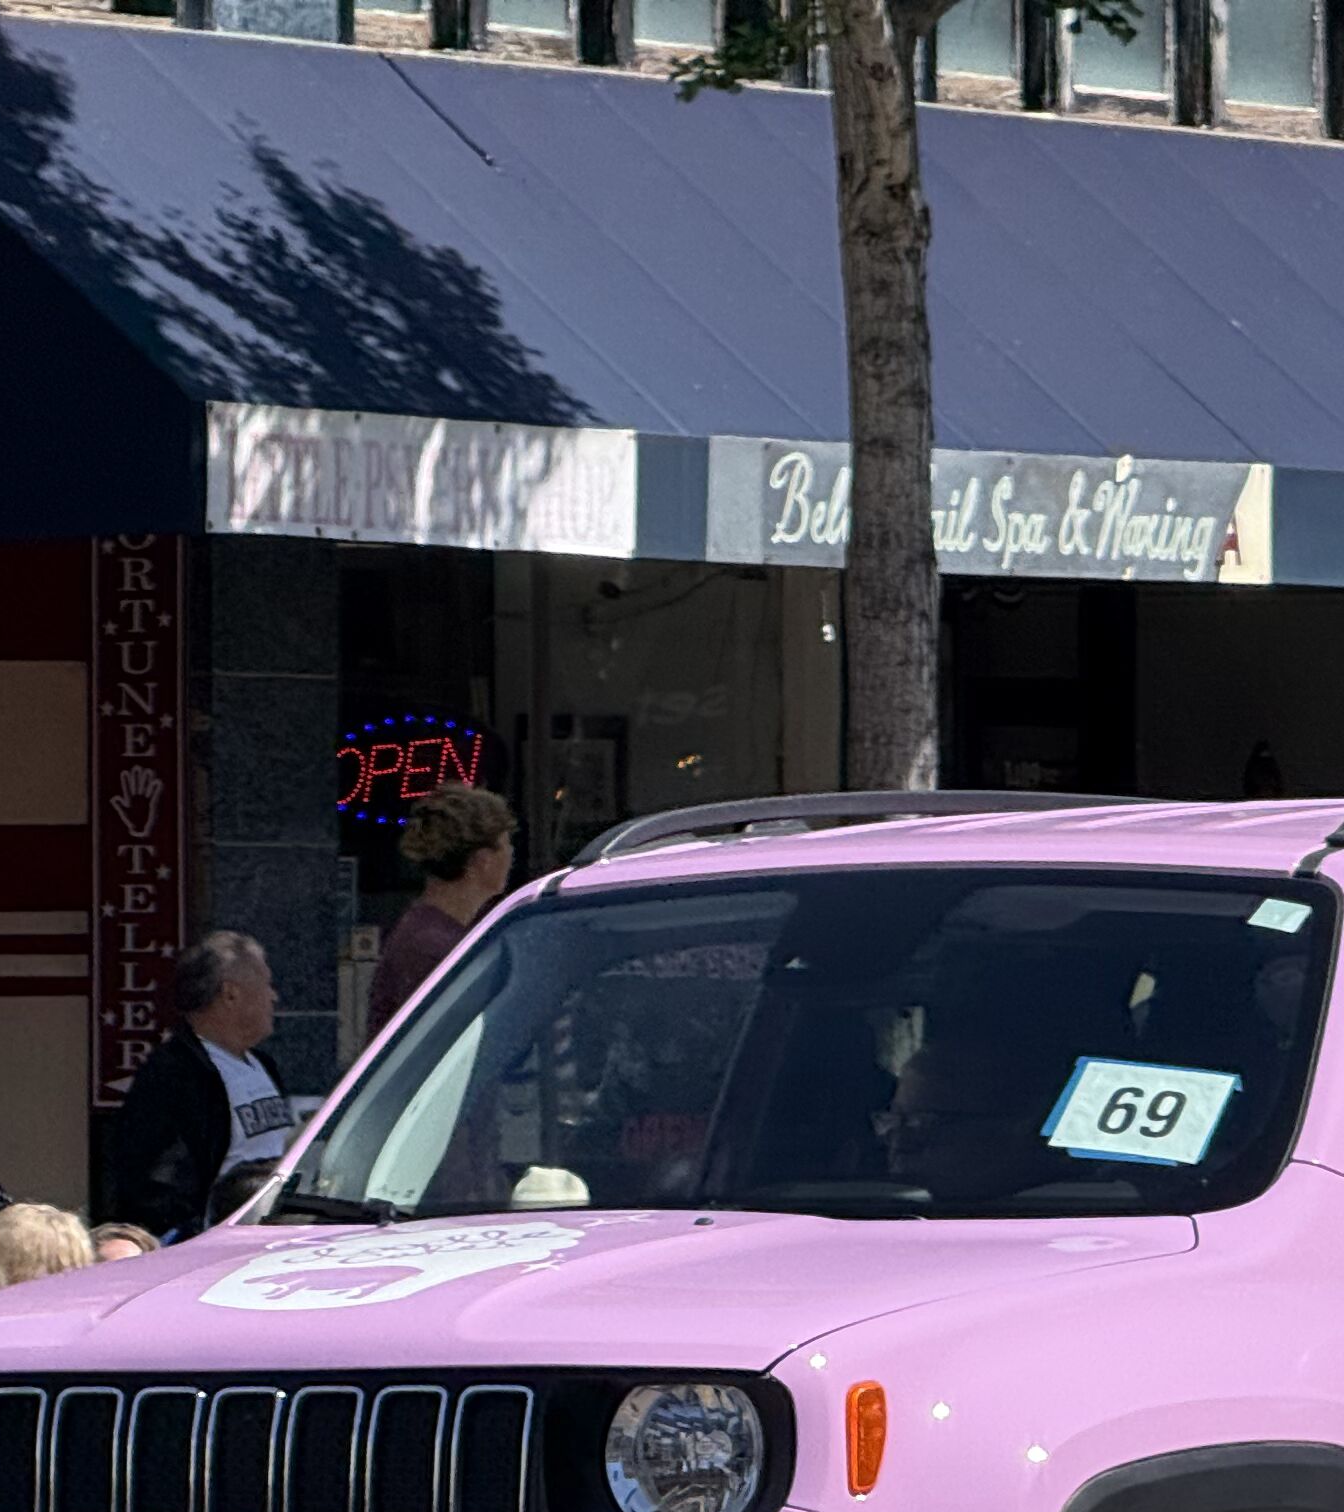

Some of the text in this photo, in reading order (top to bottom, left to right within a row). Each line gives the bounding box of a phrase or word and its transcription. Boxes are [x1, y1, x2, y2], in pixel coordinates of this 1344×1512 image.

[769, 452, 850, 545] Bel
[982, 473, 1053, 570] Spa
[1058, 468, 1103, 557] &
[1093, 477, 1218, 582] Waxing
[335, 733, 484, 805] OPEN
[116, 844, 156, 1070] TELLER
[1096, 1087, 1188, 1139] 69
